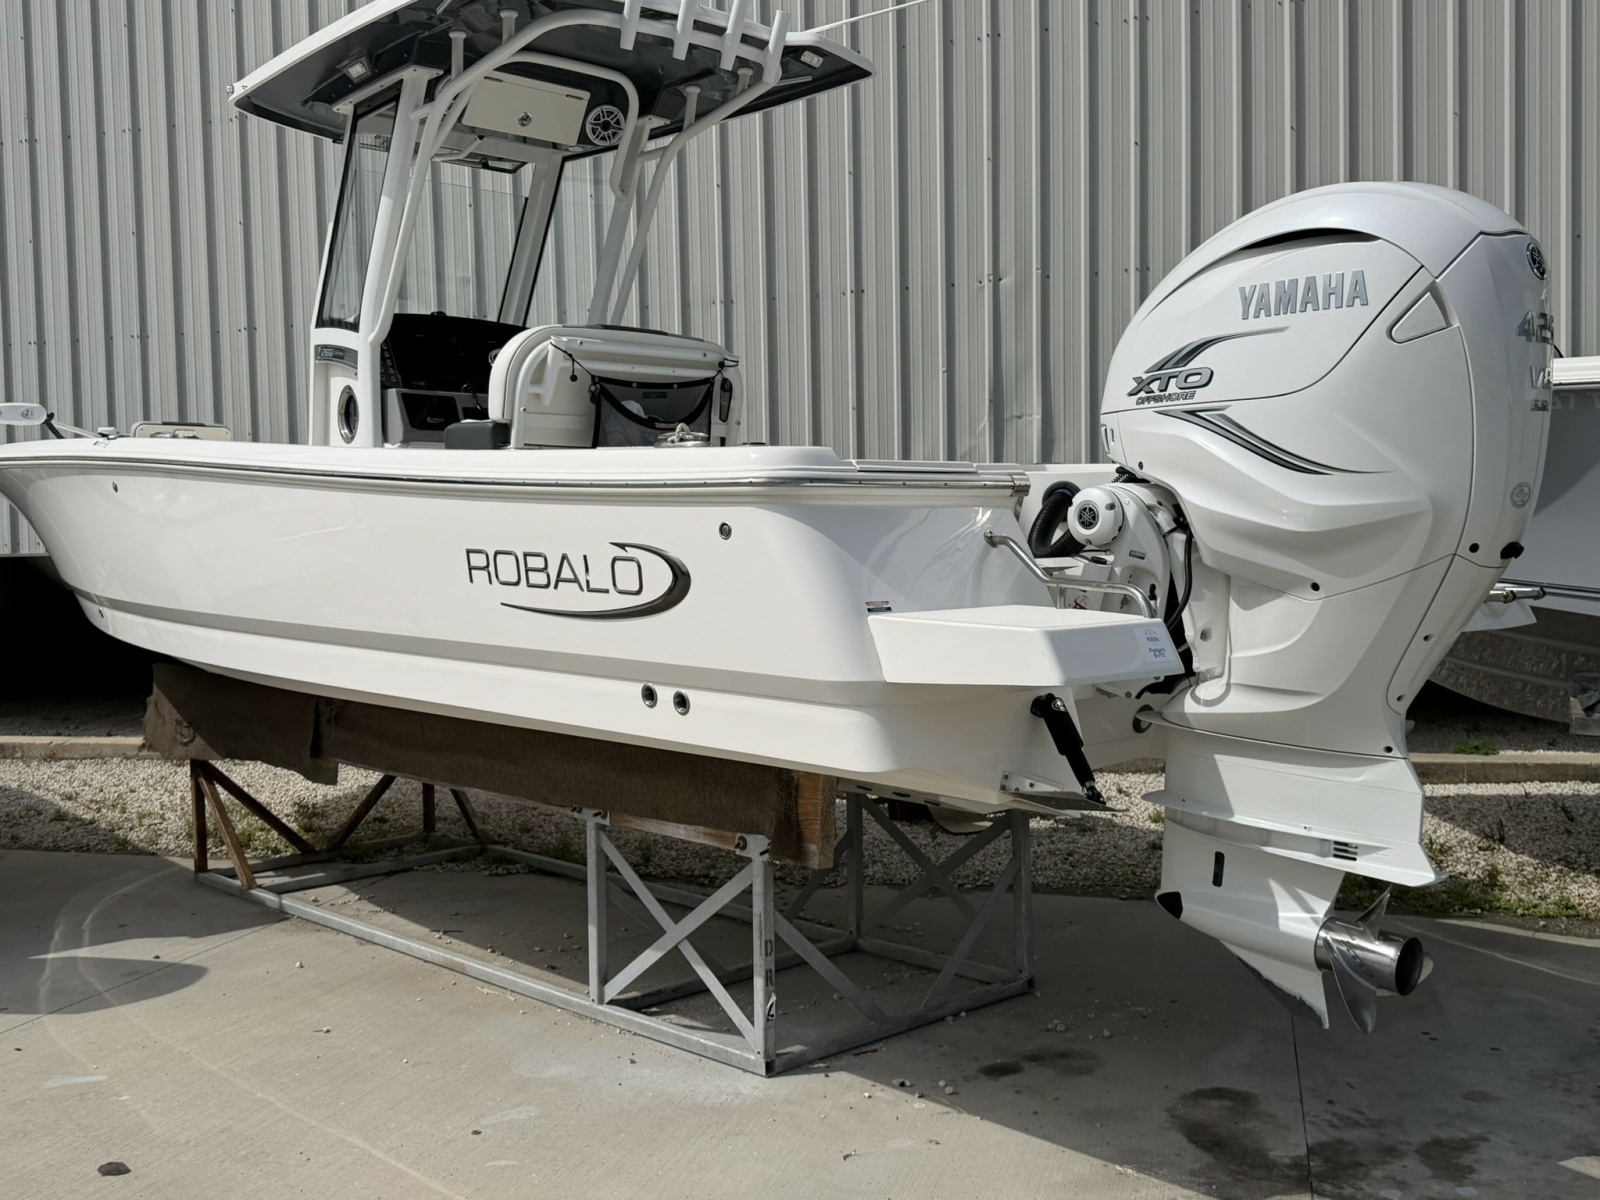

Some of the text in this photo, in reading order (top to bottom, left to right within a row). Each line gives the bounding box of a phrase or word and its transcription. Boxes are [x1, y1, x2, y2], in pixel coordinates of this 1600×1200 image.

[1238, 269, 1369, 320] YAMAHA
[1126, 367, 1215, 396] XTO
[1530, 366, 1551, 389] V8
[1136, 390, 1197, 405] OFFSHORE
[465, 547, 644, 596] ROBALO
